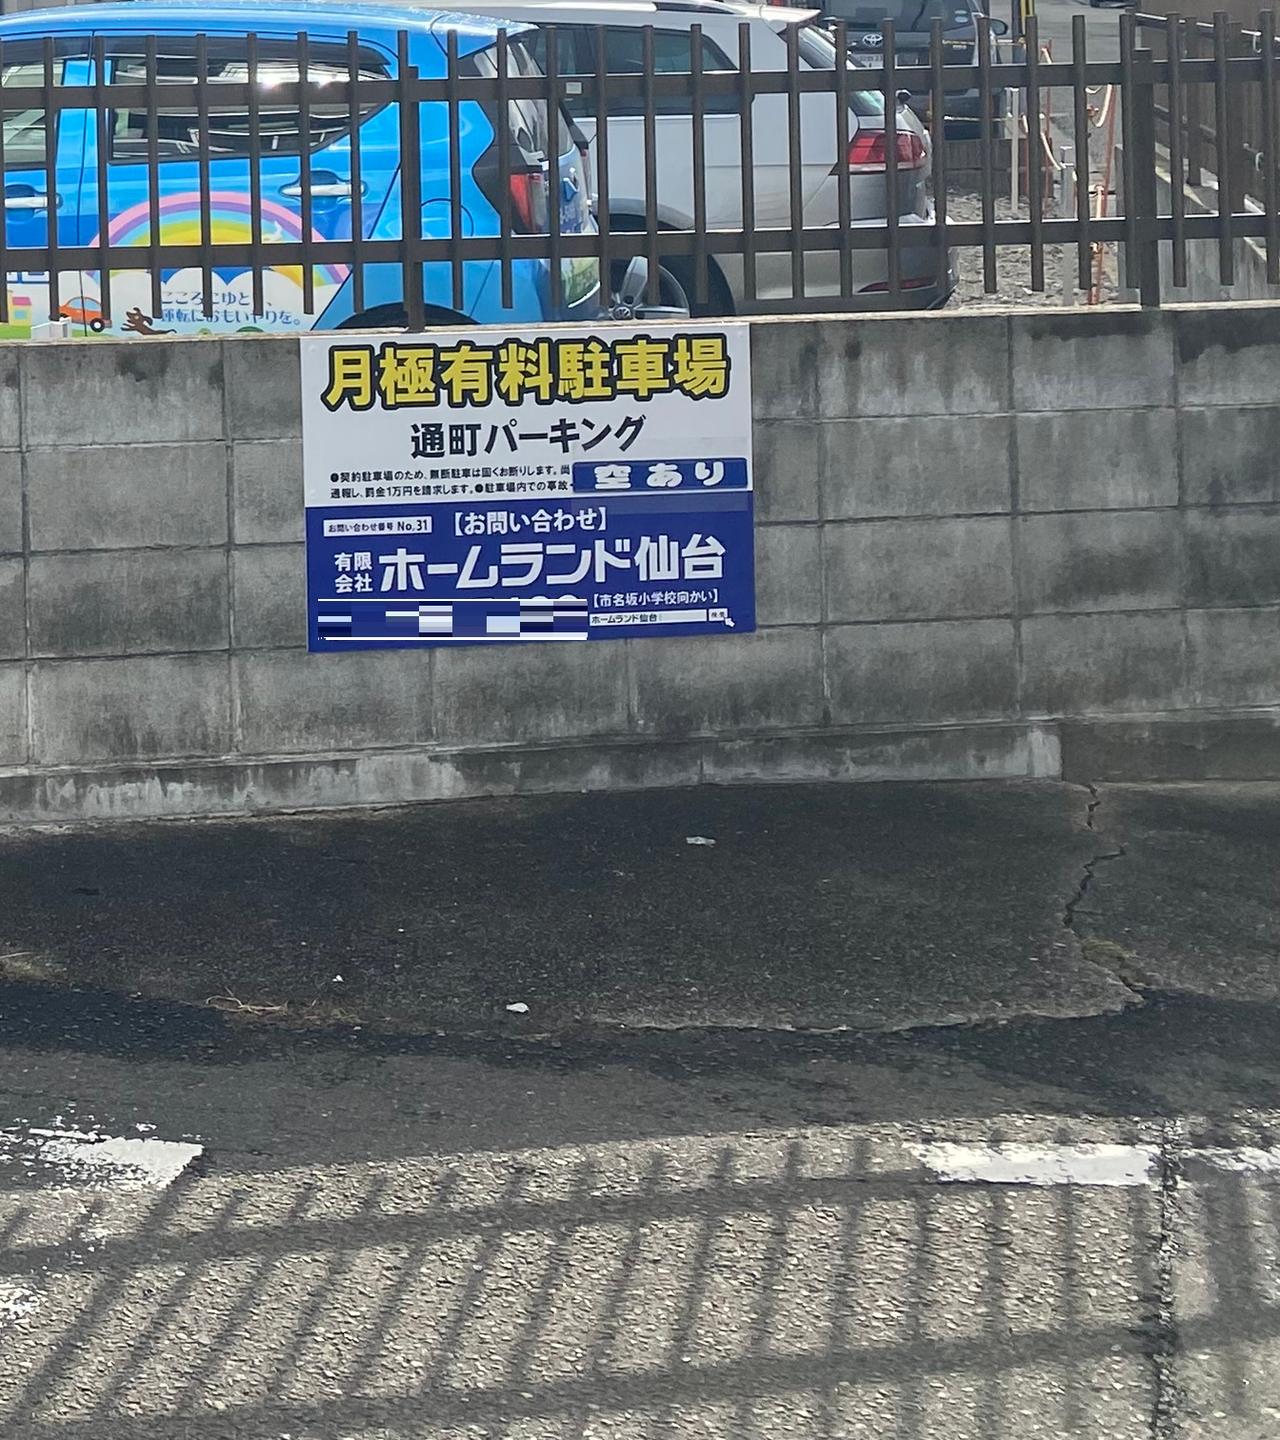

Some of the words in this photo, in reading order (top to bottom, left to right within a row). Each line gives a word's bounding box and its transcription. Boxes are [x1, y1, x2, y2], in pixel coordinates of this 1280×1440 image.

[322, 333, 732, 411] 月極有料駐車場
[410, 413, 647, 459] 通町パーキング
[593, 461, 725, 490] 空あり
[333, 551, 373, 572] 有限
[379, 532, 727, 593] ホームランド仙台
[333, 572, 374, 594] 会社
[591, 612, 658, 625] ホームランド仙台
